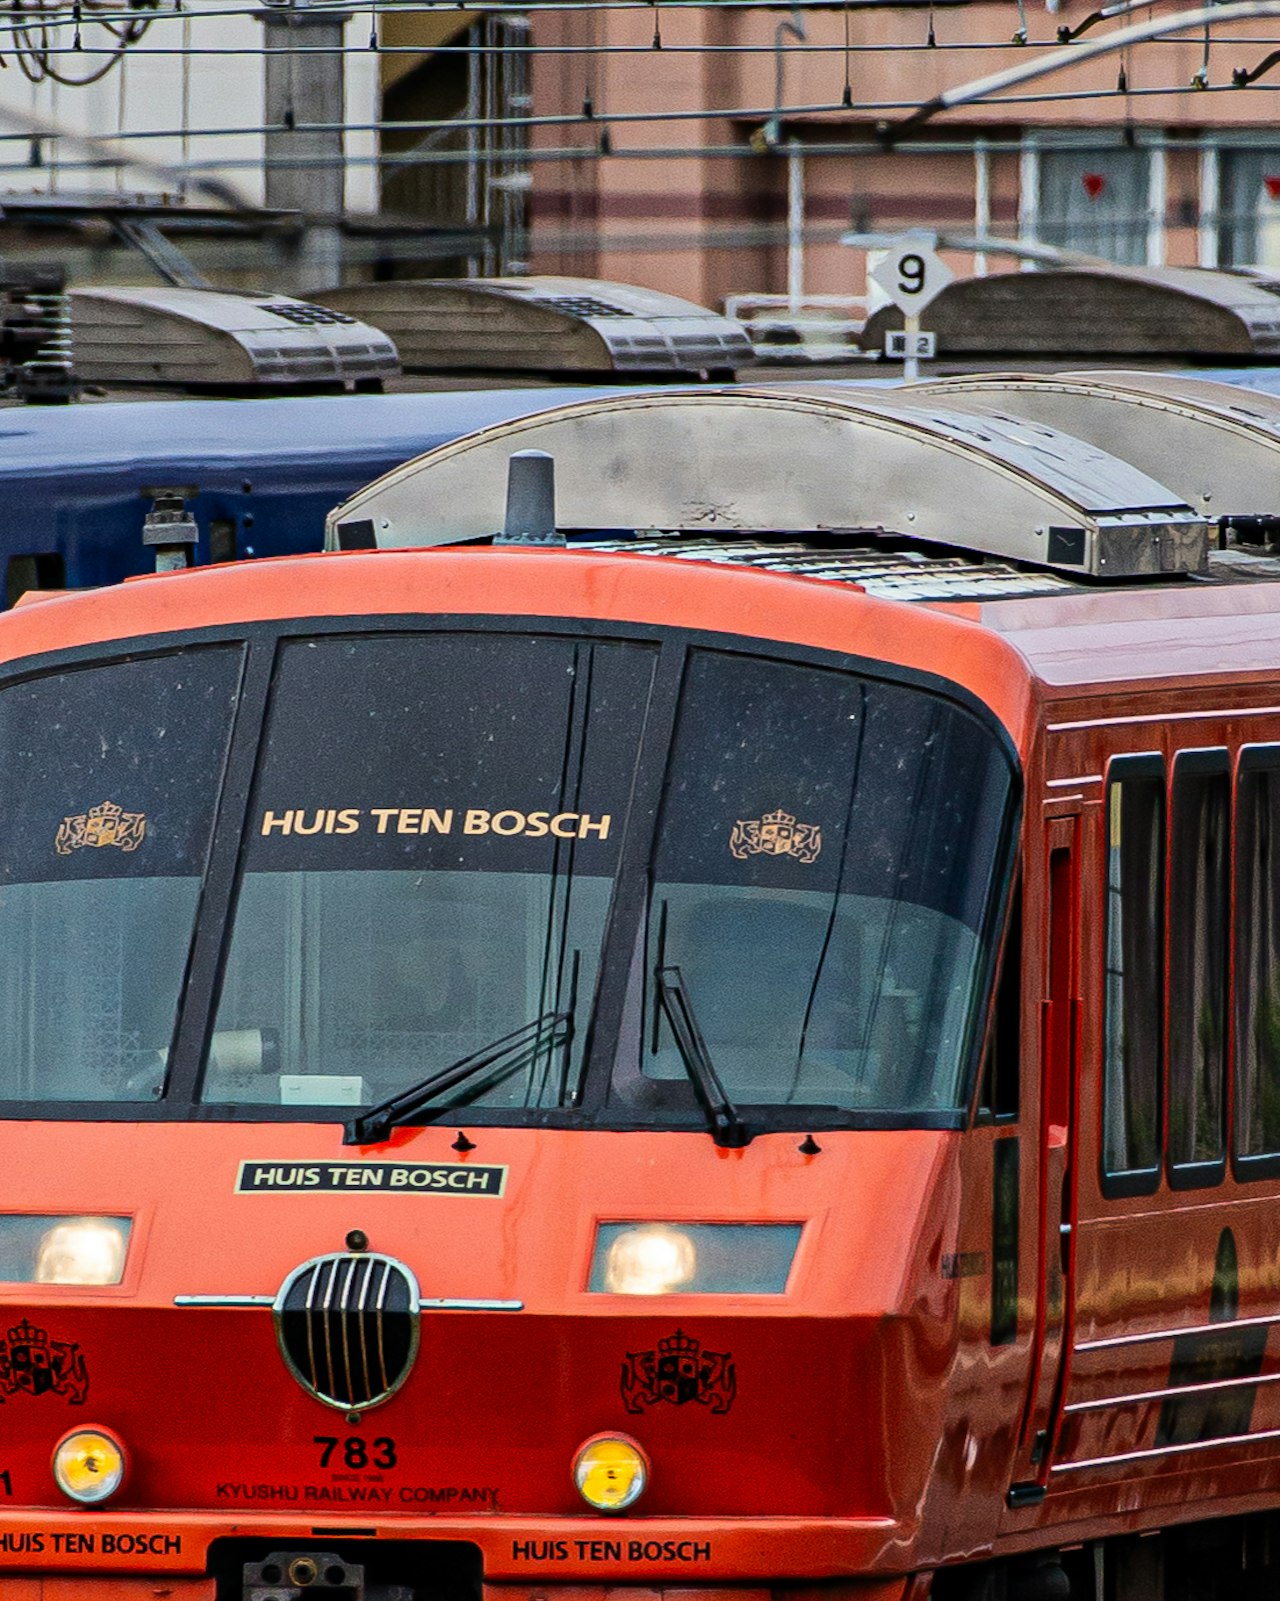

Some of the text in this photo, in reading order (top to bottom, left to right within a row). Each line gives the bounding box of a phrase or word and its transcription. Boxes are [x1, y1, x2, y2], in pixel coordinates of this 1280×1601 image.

[898, 254, 925, 294] 9
[261, 808, 611, 840] HUIS TEN BOSCH
[253, 1167, 489, 1189] HUIS TEN BOSCH
[314, 1436, 397, 1469] 783
[216, 1483, 500, 1503] KYUSHU RAILWAY COMPANY
[51, 1534, 94, 1553] TEN
[101, 1534, 181, 1554] BOSCH
[512, 1540, 710, 1561] HUIS TEN BOSCH
